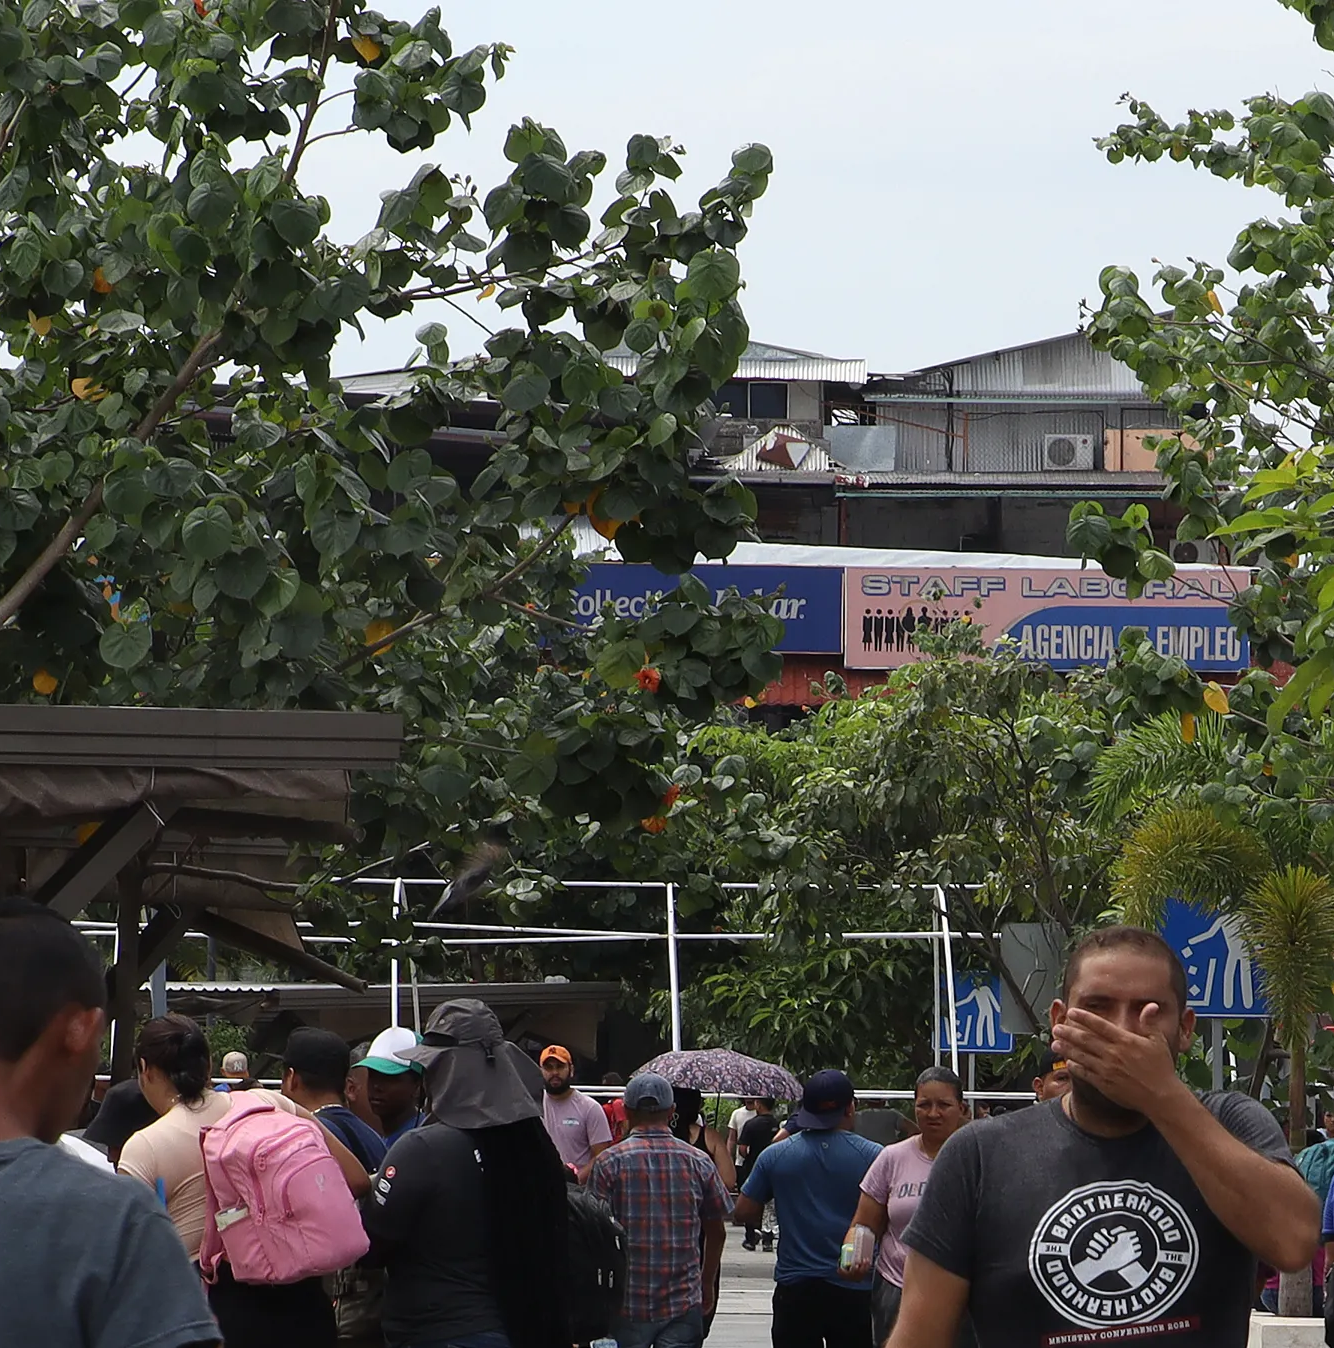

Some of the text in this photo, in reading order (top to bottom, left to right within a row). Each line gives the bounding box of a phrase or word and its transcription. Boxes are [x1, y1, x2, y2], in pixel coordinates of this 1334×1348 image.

[862, 575, 1237, 599] STAFF LABORAL
[1020, 624, 1116, 660] AGENCIA
[1156, 626, 1241, 661] EMPLEO
[1051, 1193, 1182, 1243] BROTHERHOOD
[1045, 1244, 1063, 1254] THE
[1165, 1252, 1183, 1263] THE
[1045, 1259, 1177, 1317] BROTHERHOOD
[1100, 1324, 1165, 1339] CONFERENCE
